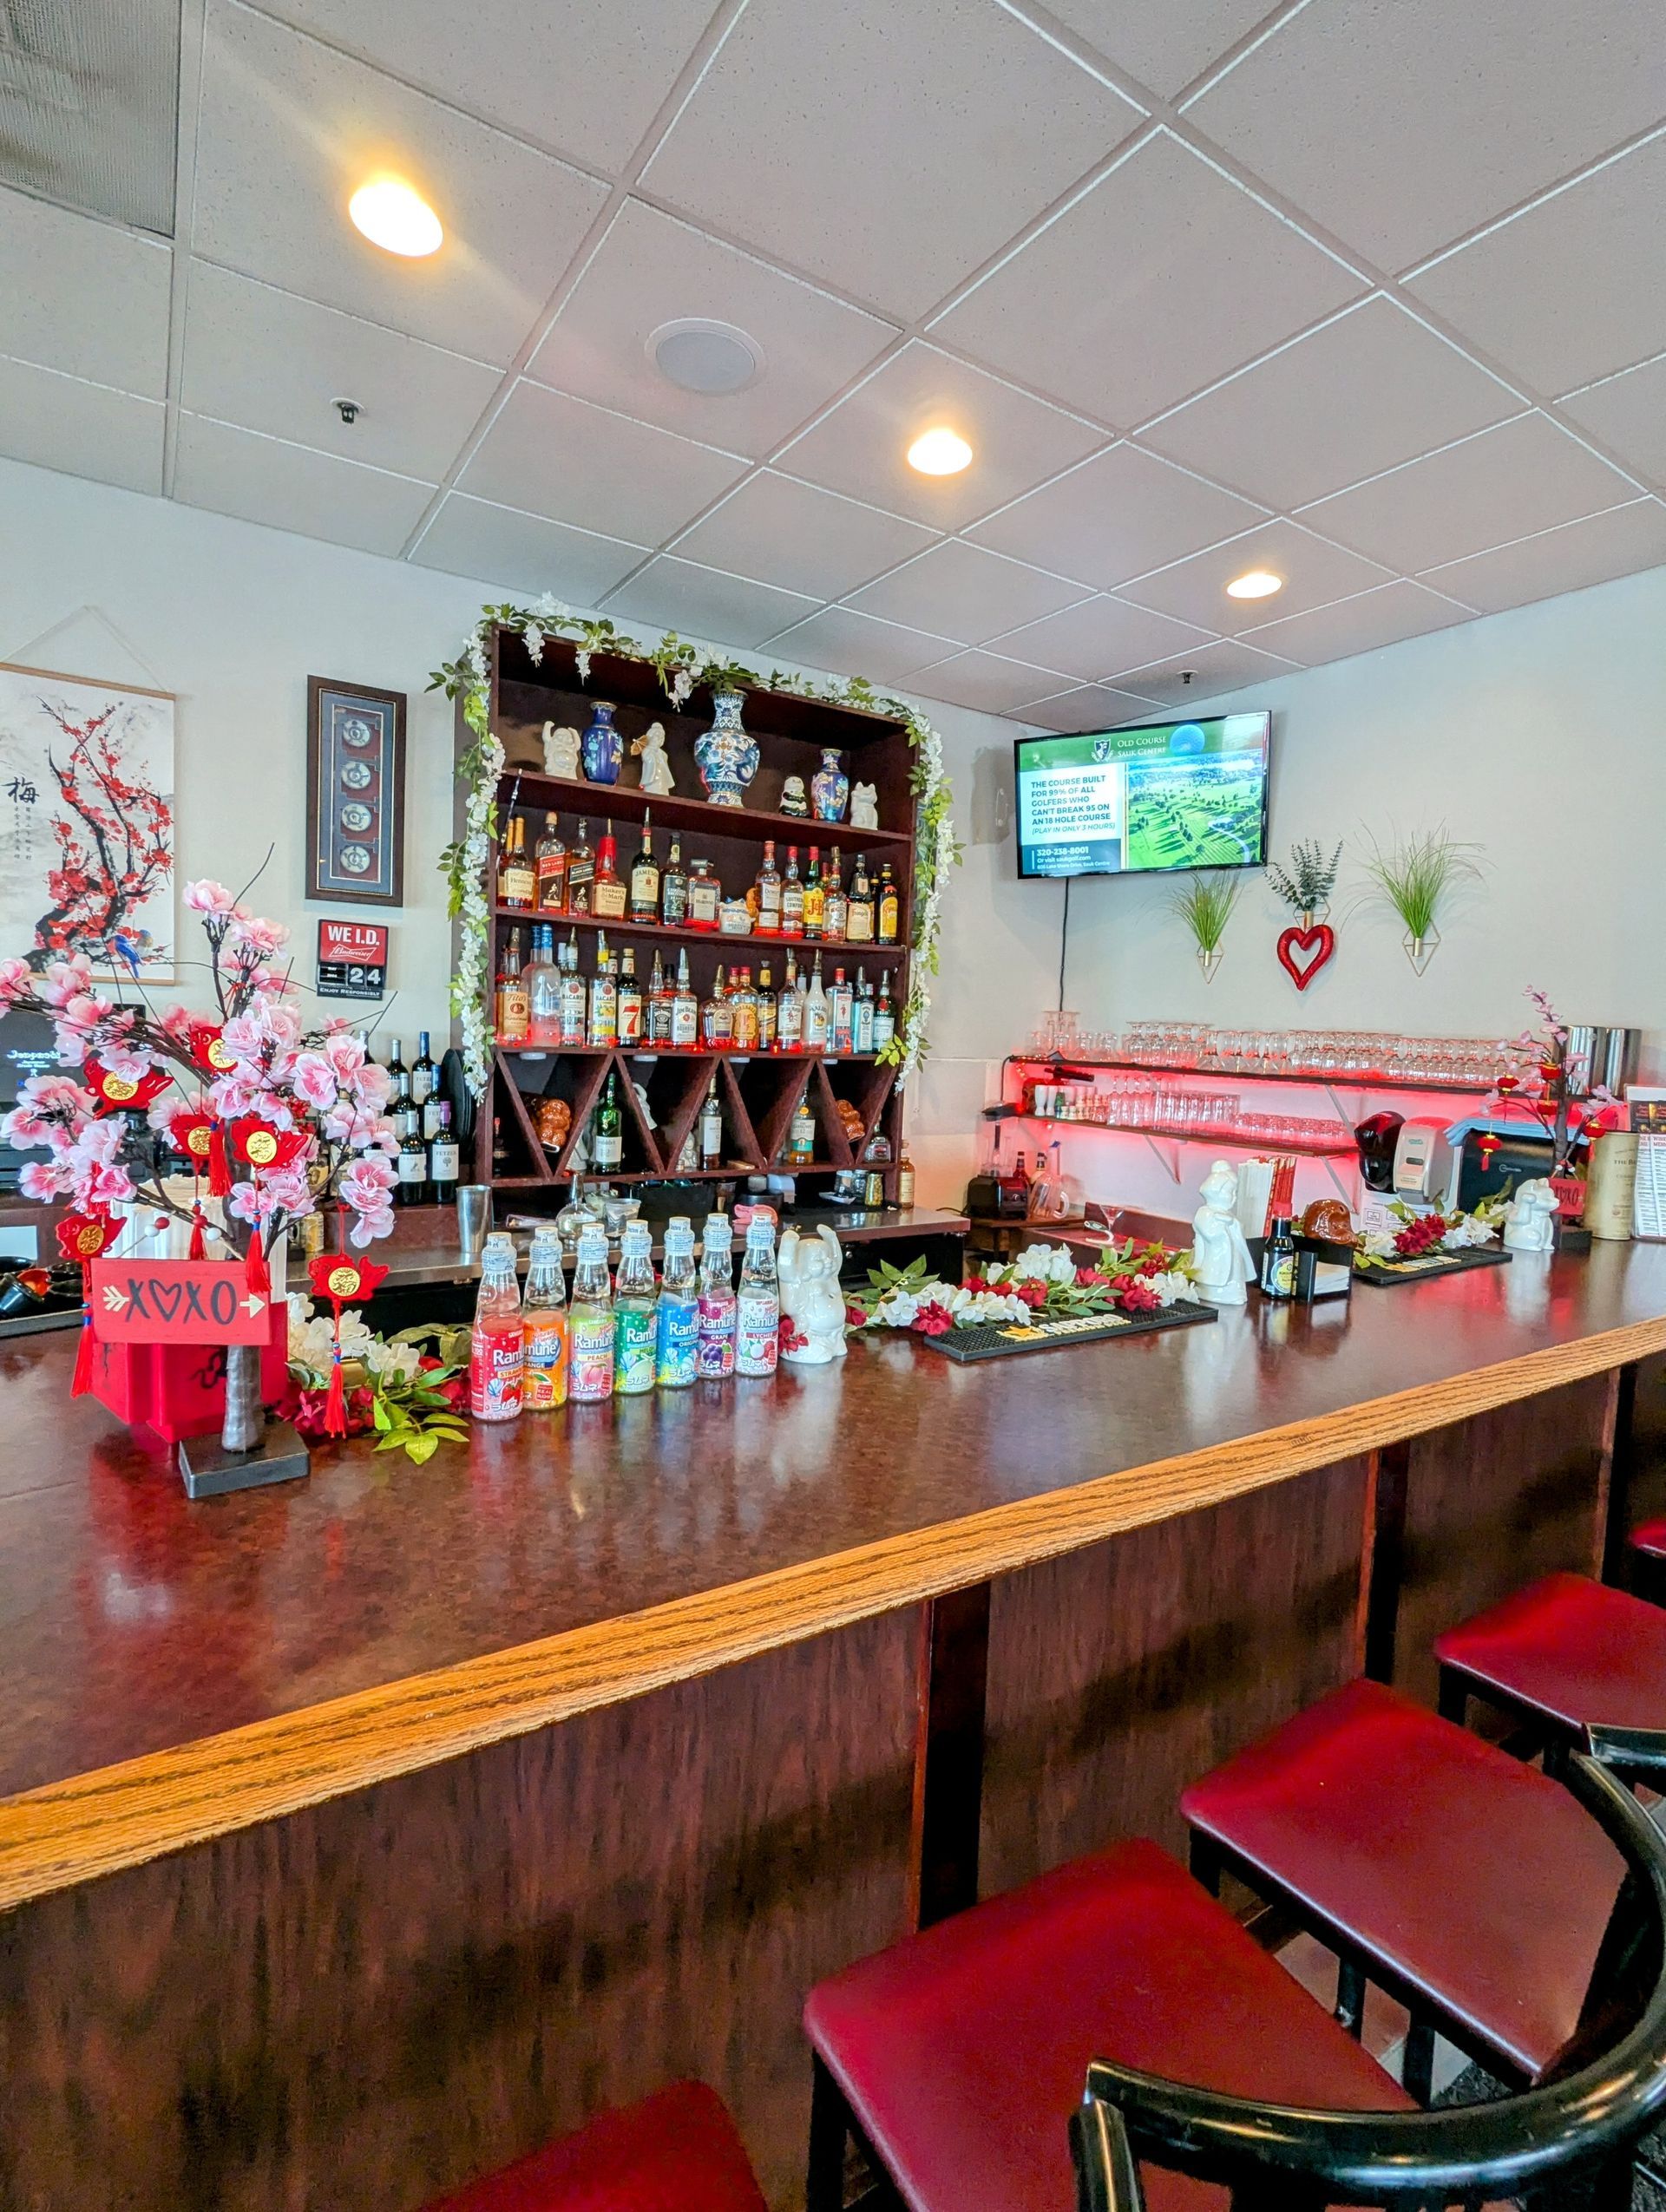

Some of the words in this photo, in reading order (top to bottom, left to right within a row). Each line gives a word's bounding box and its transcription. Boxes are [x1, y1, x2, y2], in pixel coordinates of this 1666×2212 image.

[1117, 739, 1134, 748] OLD
[1136, 736, 1166, 746] COURSE
[1118, 749, 1137, 758] SAUK
[1138, 747, 1166, 756] CENTRE
[1048, 777, 1081, 786] COURSE
[1, 776, 40, 804] 梅
[1048, 788, 1066, 796] 99%
[1031, 798, 1067, 807] GOLFERS
[1031, 808, 1055, 816] CAN'T
[1055, 815, 1076, 824] HOLE
[1078, 812, 1111, 822] COURSE
[1087, 822, 1116, 831] HOURS)
[1036, 846, 1090, 857] 320-238-8001
[328, 925, 352, 943] WE
[356, 928, 380, 946] I.D.
[334, 946, 371, 958] Budweiser
[623, 1005, 640, 1034] 7
[679, 1339, 699, 1348] ORIGIN
